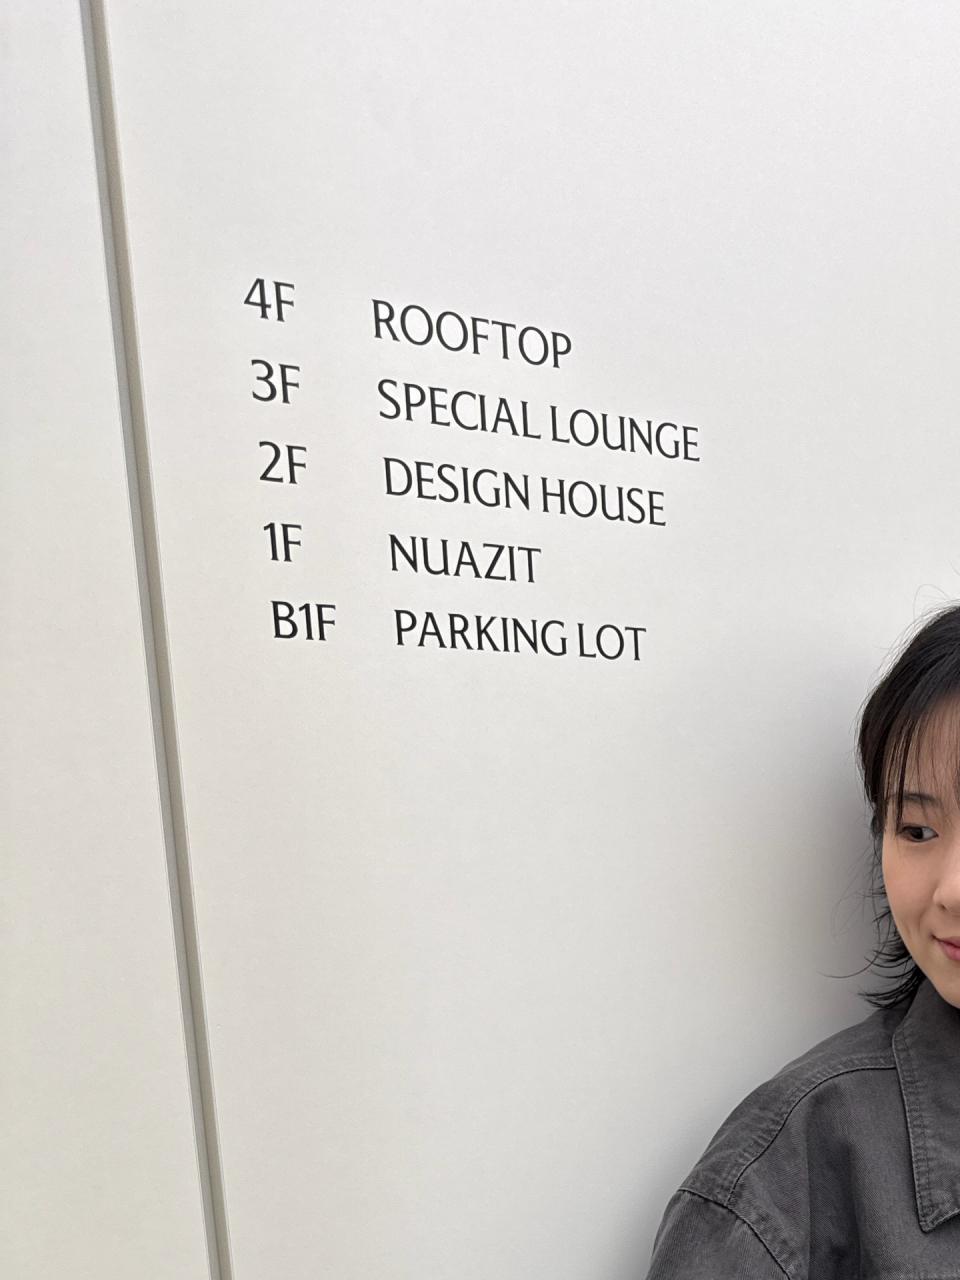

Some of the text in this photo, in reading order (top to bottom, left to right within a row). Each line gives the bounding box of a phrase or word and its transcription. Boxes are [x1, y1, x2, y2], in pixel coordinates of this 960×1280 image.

[243, 278, 572, 369] 4F ROOFTOP
[251, 359, 700, 462] 3F SPECIAL LOUNGE
[259, 440, 666, 527] 2F DESIGN HOUSE
[263, 522, 542, 583] 1F NUAZIT
[271, 600, 647, 661] B1F PARKING LOT
